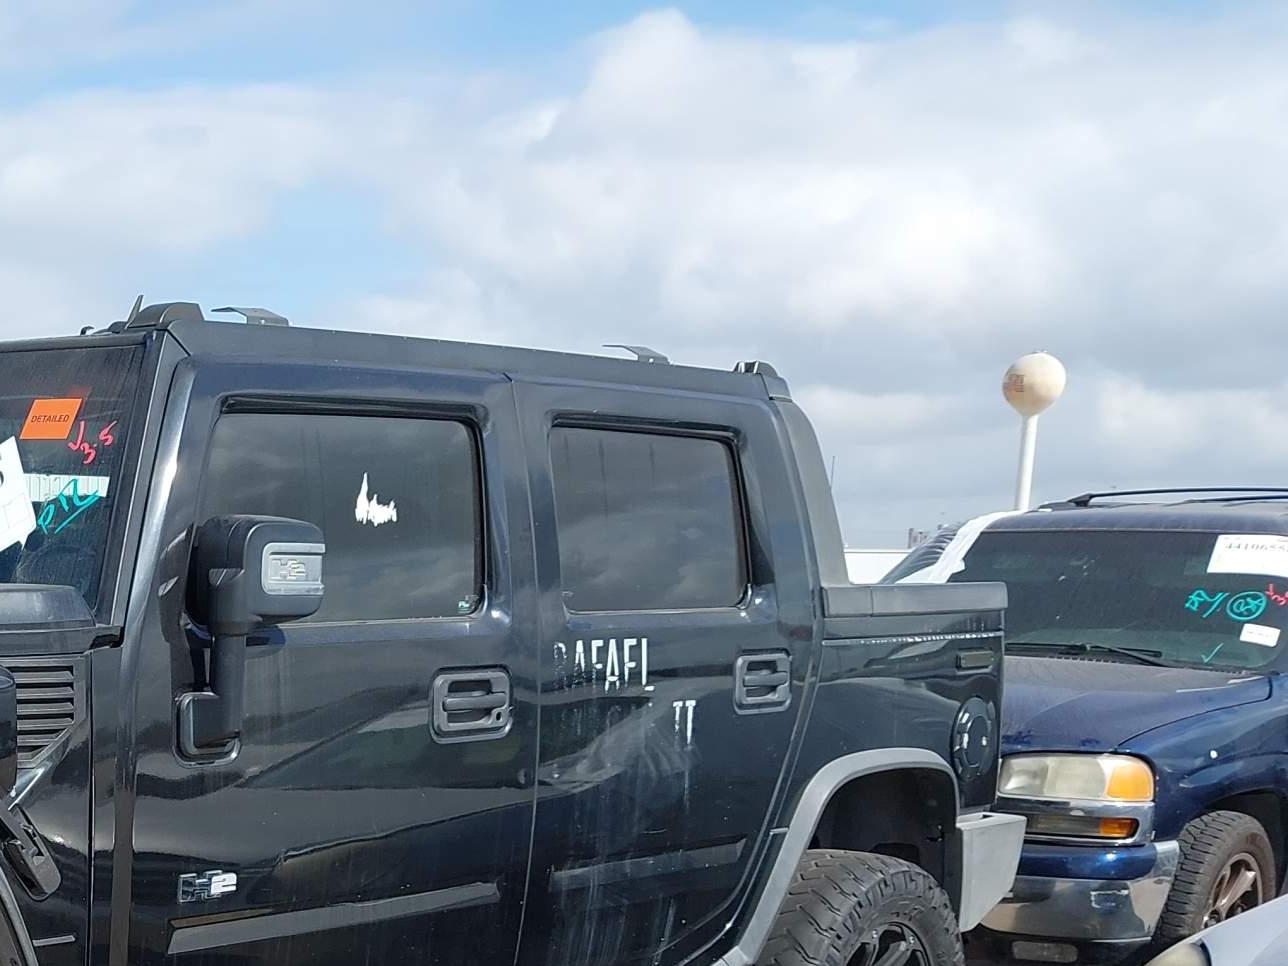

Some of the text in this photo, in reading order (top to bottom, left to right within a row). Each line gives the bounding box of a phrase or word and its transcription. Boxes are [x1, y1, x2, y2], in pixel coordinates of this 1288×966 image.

[30, 414, 70, 424] DETAILED
[271, 558, 306, 580] H2
[177, 869, 238, 903] H2
